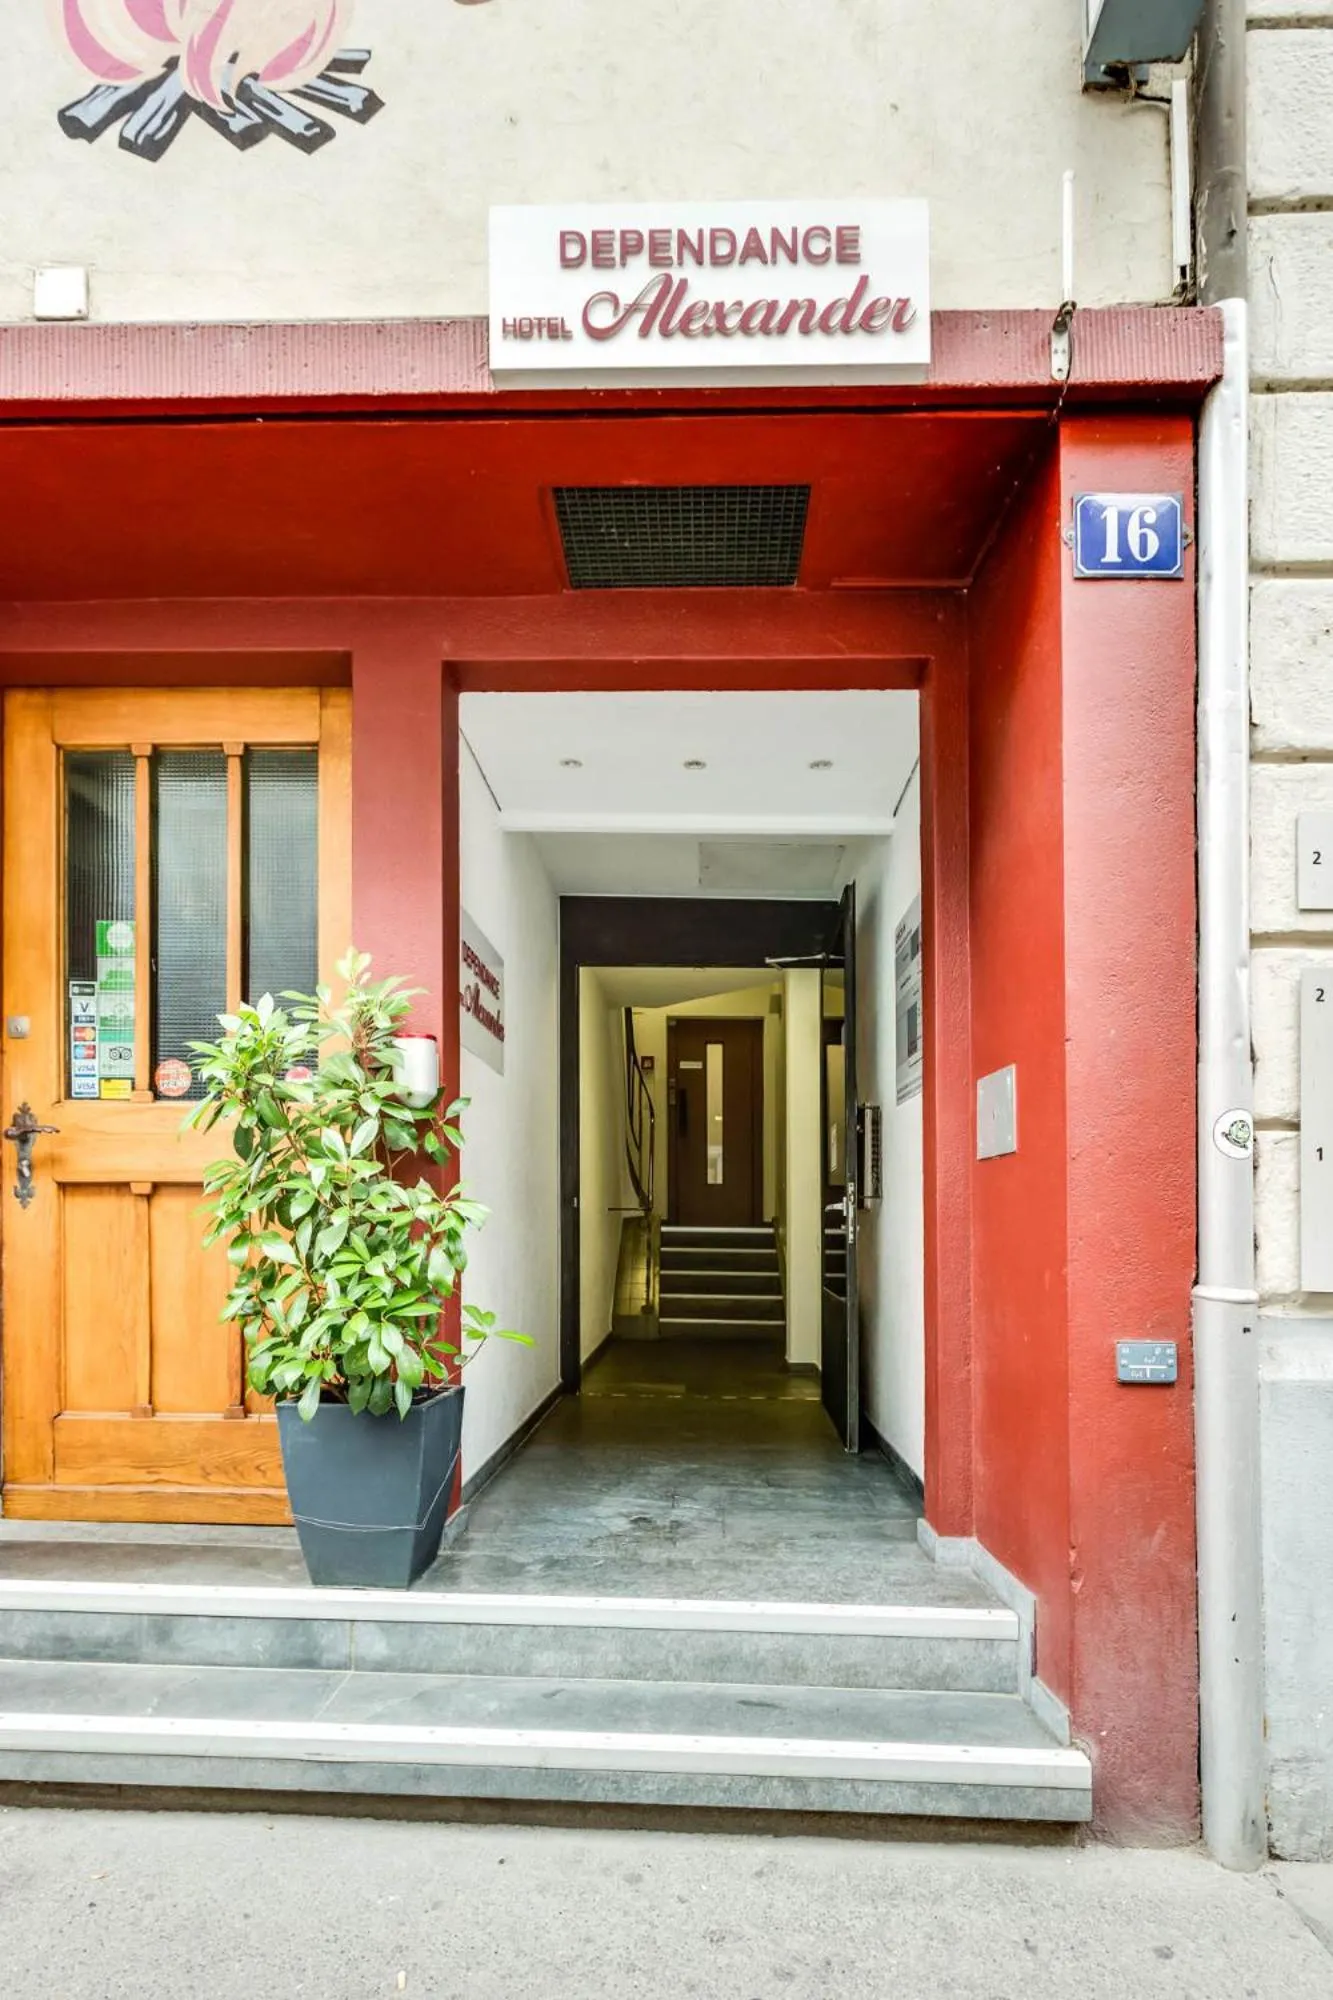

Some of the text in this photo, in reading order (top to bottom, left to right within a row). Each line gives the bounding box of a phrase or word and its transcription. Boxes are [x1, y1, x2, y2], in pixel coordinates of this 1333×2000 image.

[559, 225, 861, 268] DEPENDANCE
[502, 272, 918, 342] HOTEL Alexander
[1099, 505, 1160, 564] 16
[1312, 851, 1322, 865] 2
[1315, 987, 1325, 1002] 2
[1316, 1146, 1323, 1161] 1
